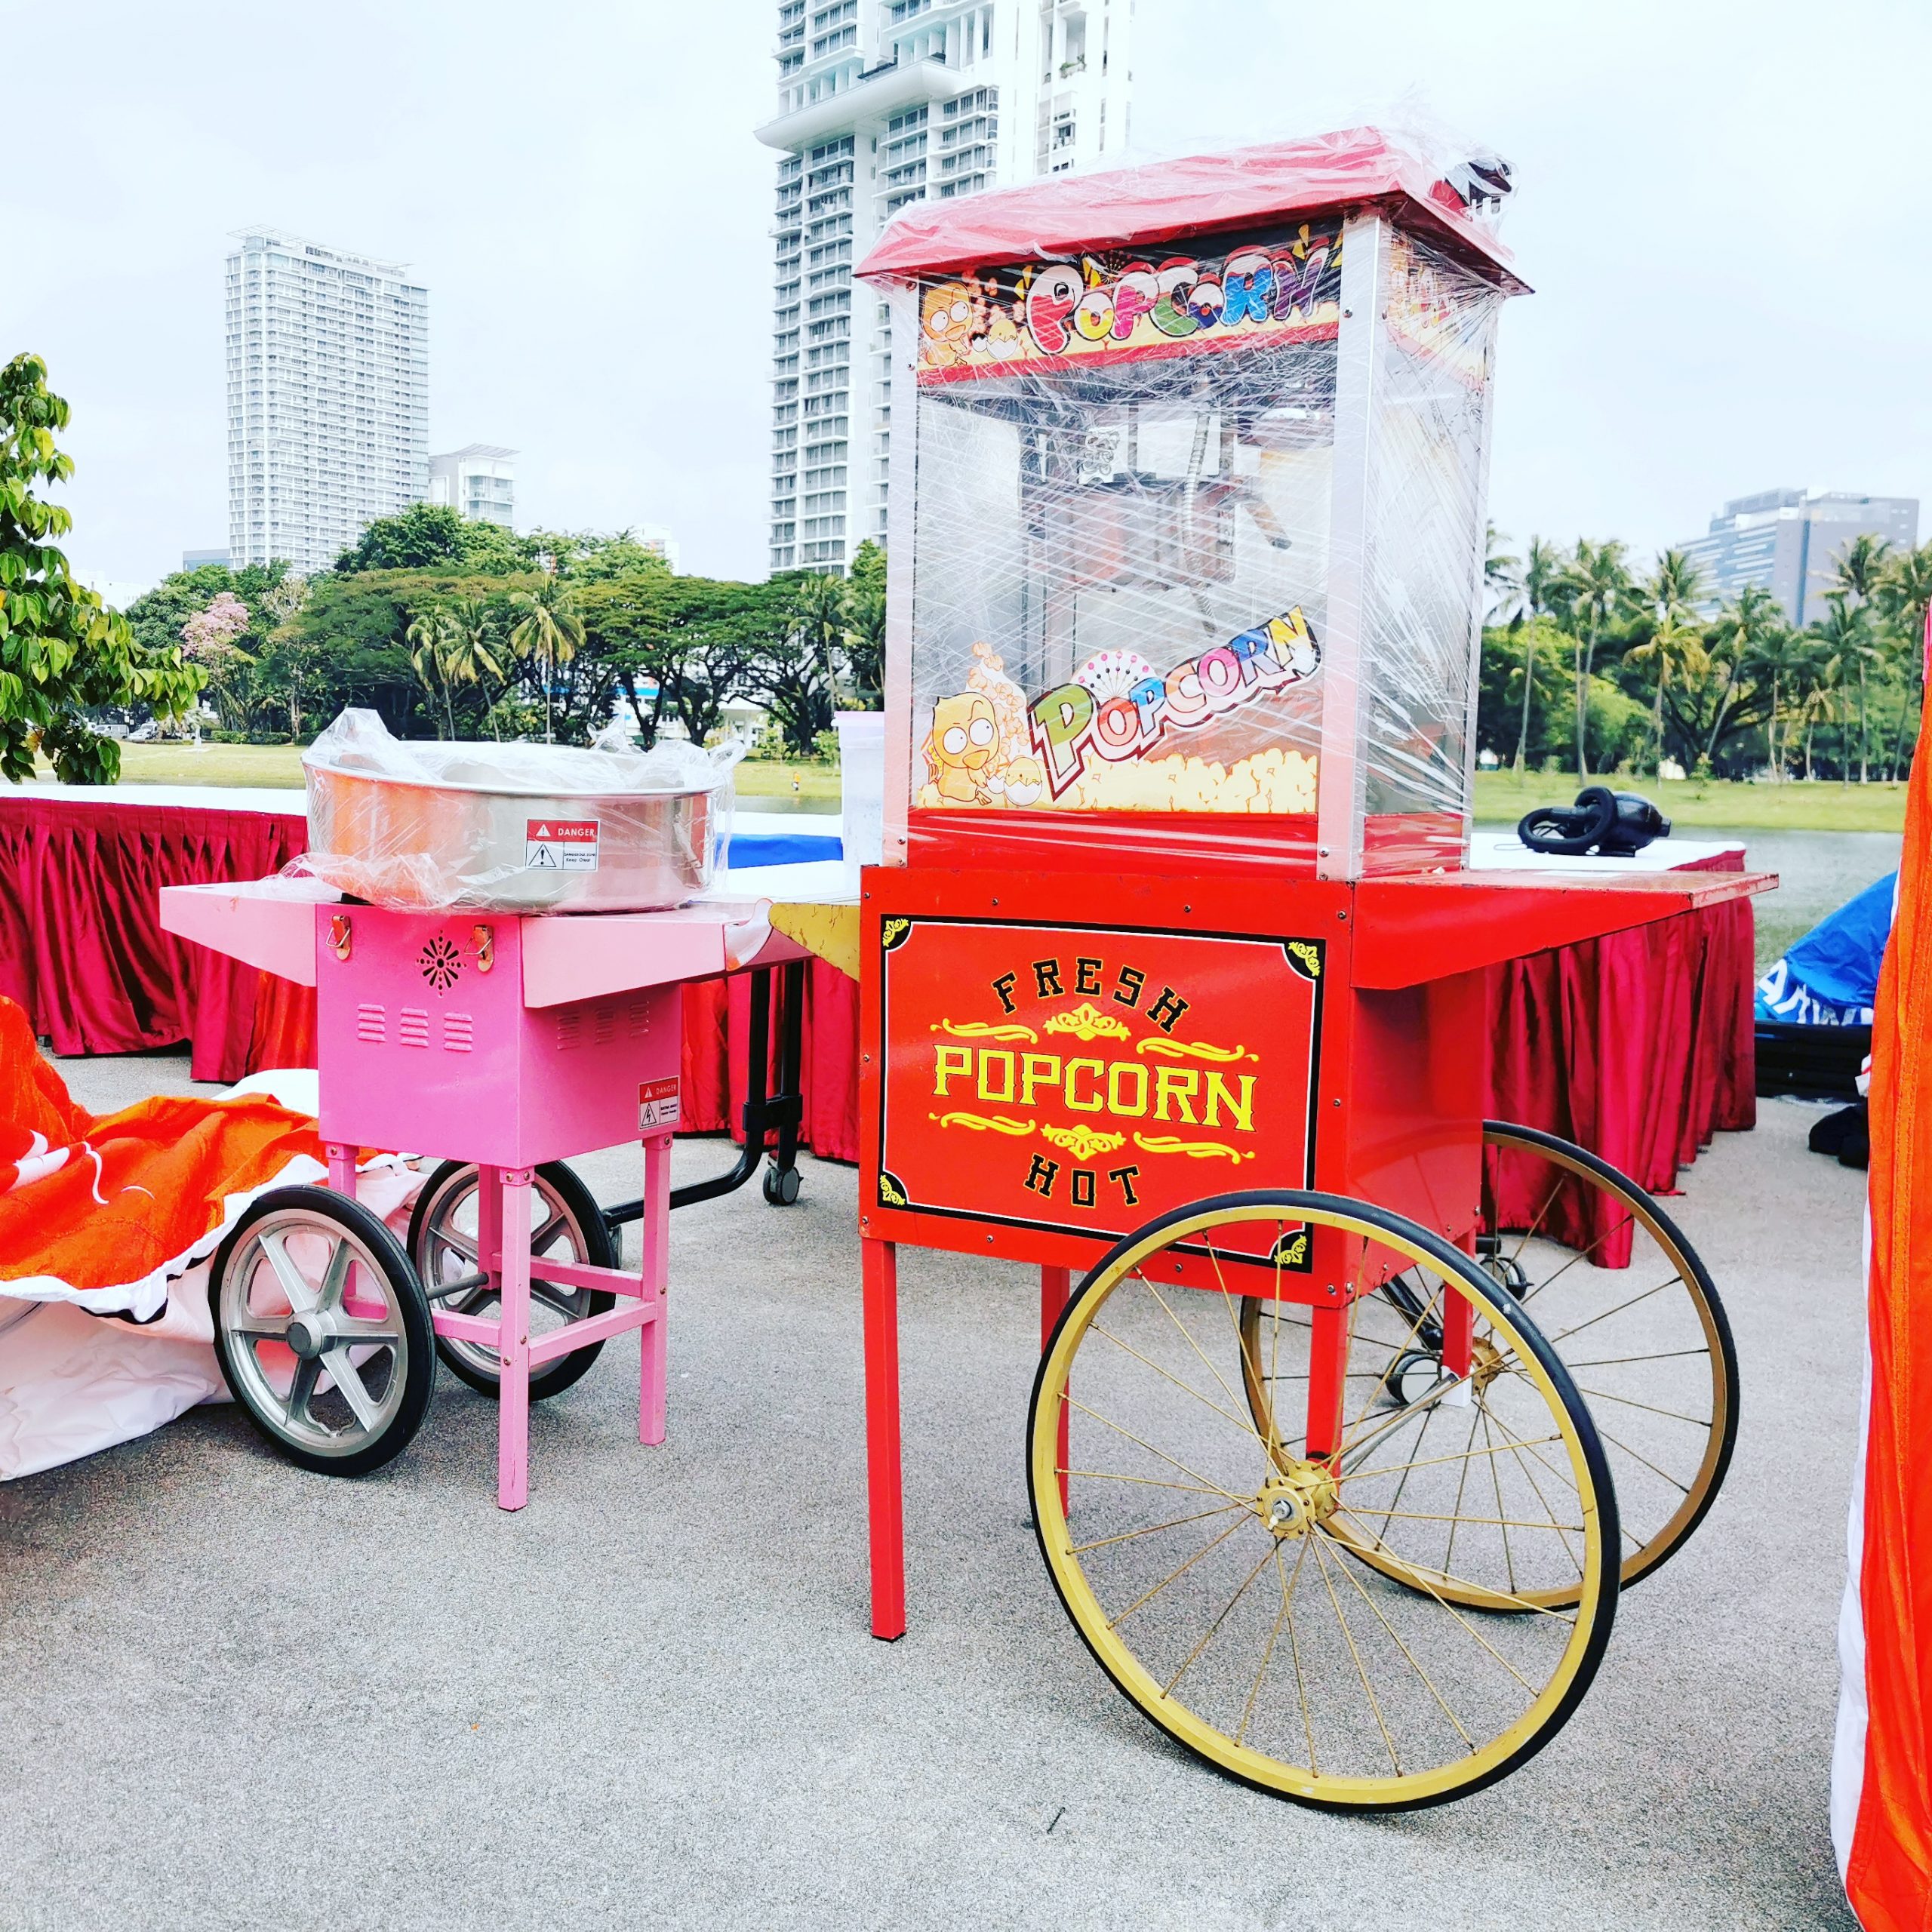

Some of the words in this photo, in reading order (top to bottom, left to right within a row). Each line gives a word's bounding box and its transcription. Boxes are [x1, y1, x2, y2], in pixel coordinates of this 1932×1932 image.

[1029, 605, 1320, 798] POPCORN
[558, 828, 595, 836] DANGER
[991, 957, 1190, 1034] FRESH
[656, 1084, 676, 1094] DANGER
[932, 1044, 1259, 1132] POPCORN
[1023, 1153, 1140, 1209] HOT
